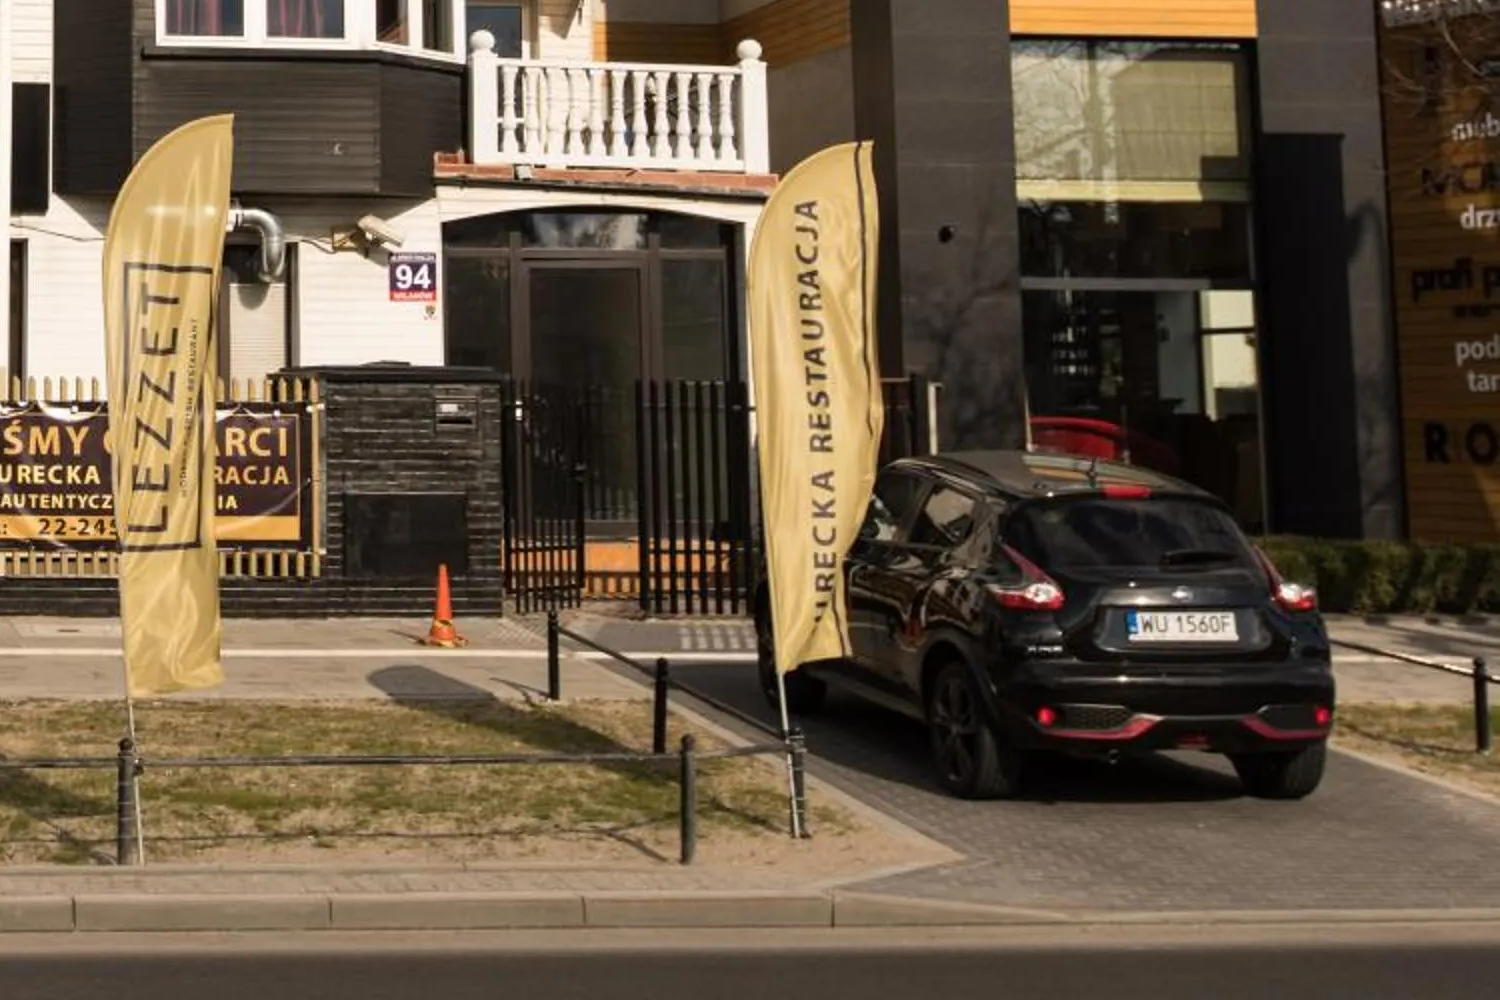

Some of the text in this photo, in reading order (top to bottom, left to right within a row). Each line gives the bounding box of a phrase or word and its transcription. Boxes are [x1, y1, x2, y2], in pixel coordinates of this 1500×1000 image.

[395, 264, 431, 289] 94
[794, 200, 834, 454] RESTAURACJA
[128, 283, 182, 533] LEZZET
[0, 493, 113, 510] AUTENTYCZ
[1140, 615, 1230, 633] WU 1560F
